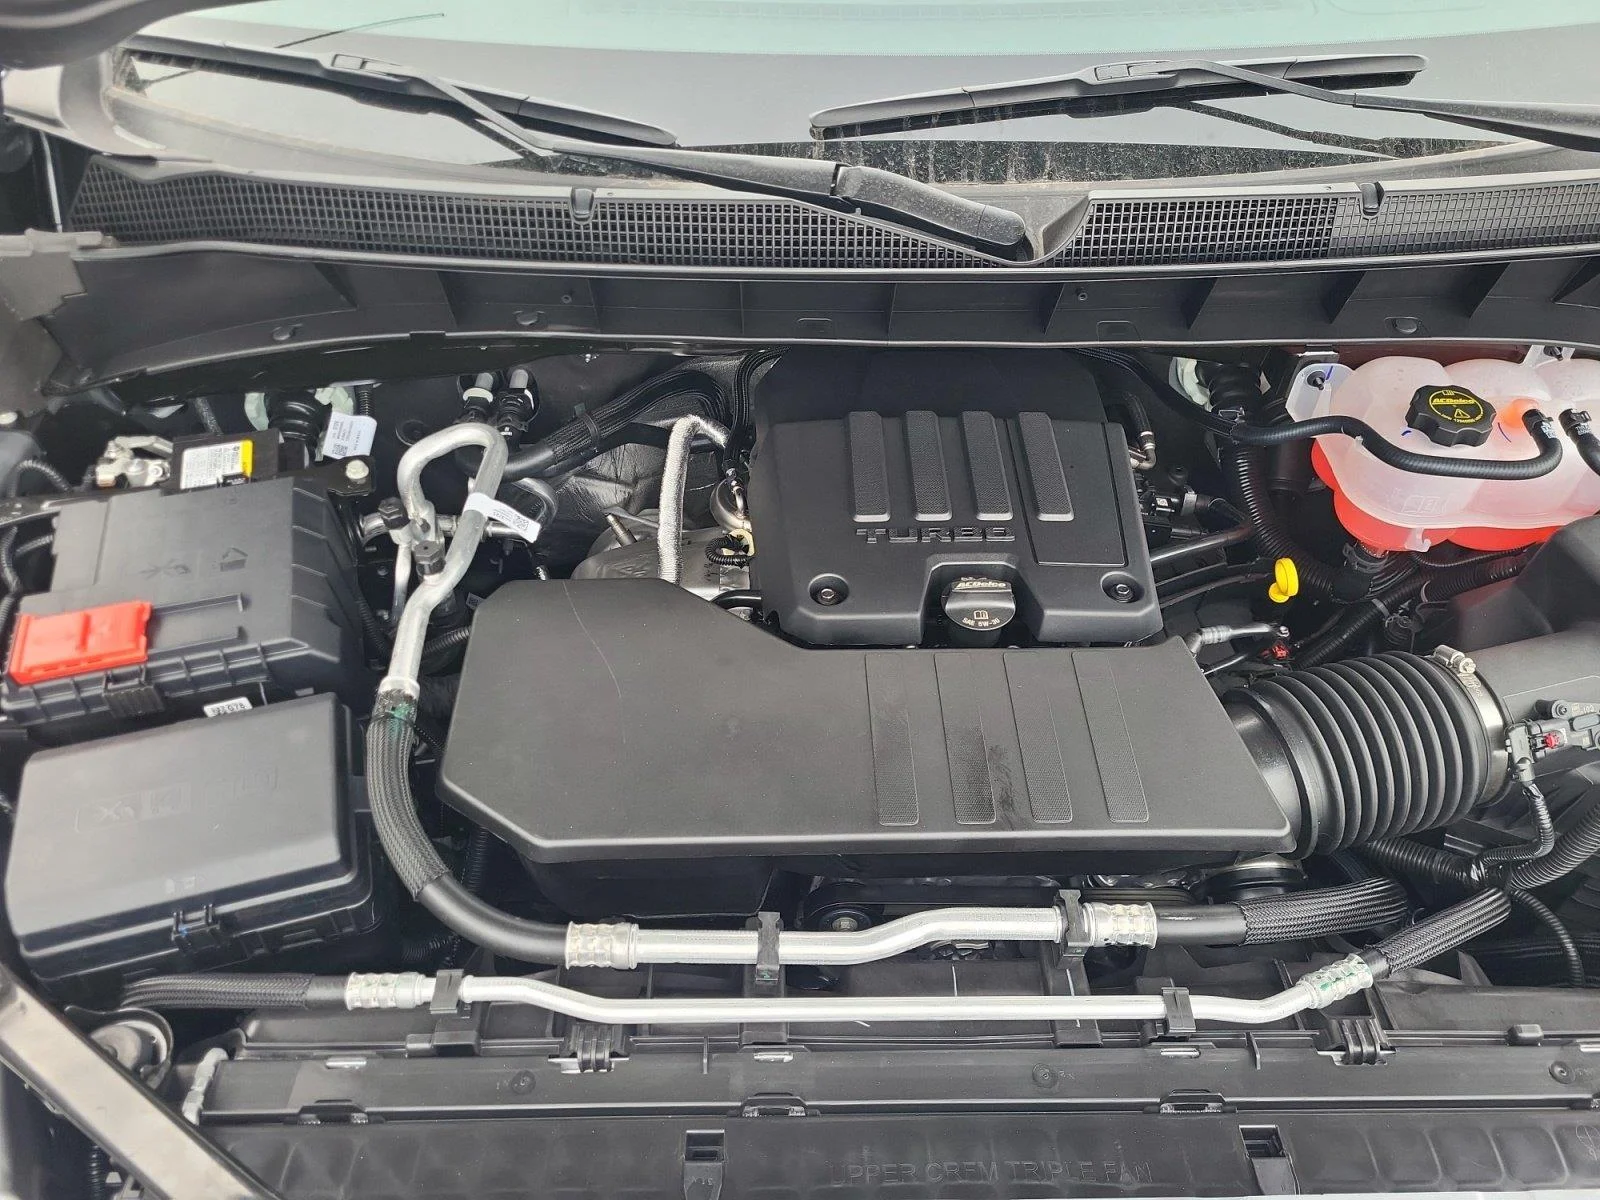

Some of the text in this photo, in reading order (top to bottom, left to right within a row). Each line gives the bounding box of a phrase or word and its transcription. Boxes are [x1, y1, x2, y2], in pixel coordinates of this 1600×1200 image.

[856, 527, 1016, 544] TURBO
[955, 581, 1006, 590] ACDelco
[962, 617, 976, 626] SAE
[831, 1162, 917, 1184] UPPER
[1004, 1160, 1097, 1183] TRIPLE
[1103, 1160, 1153, 1183] FAN
